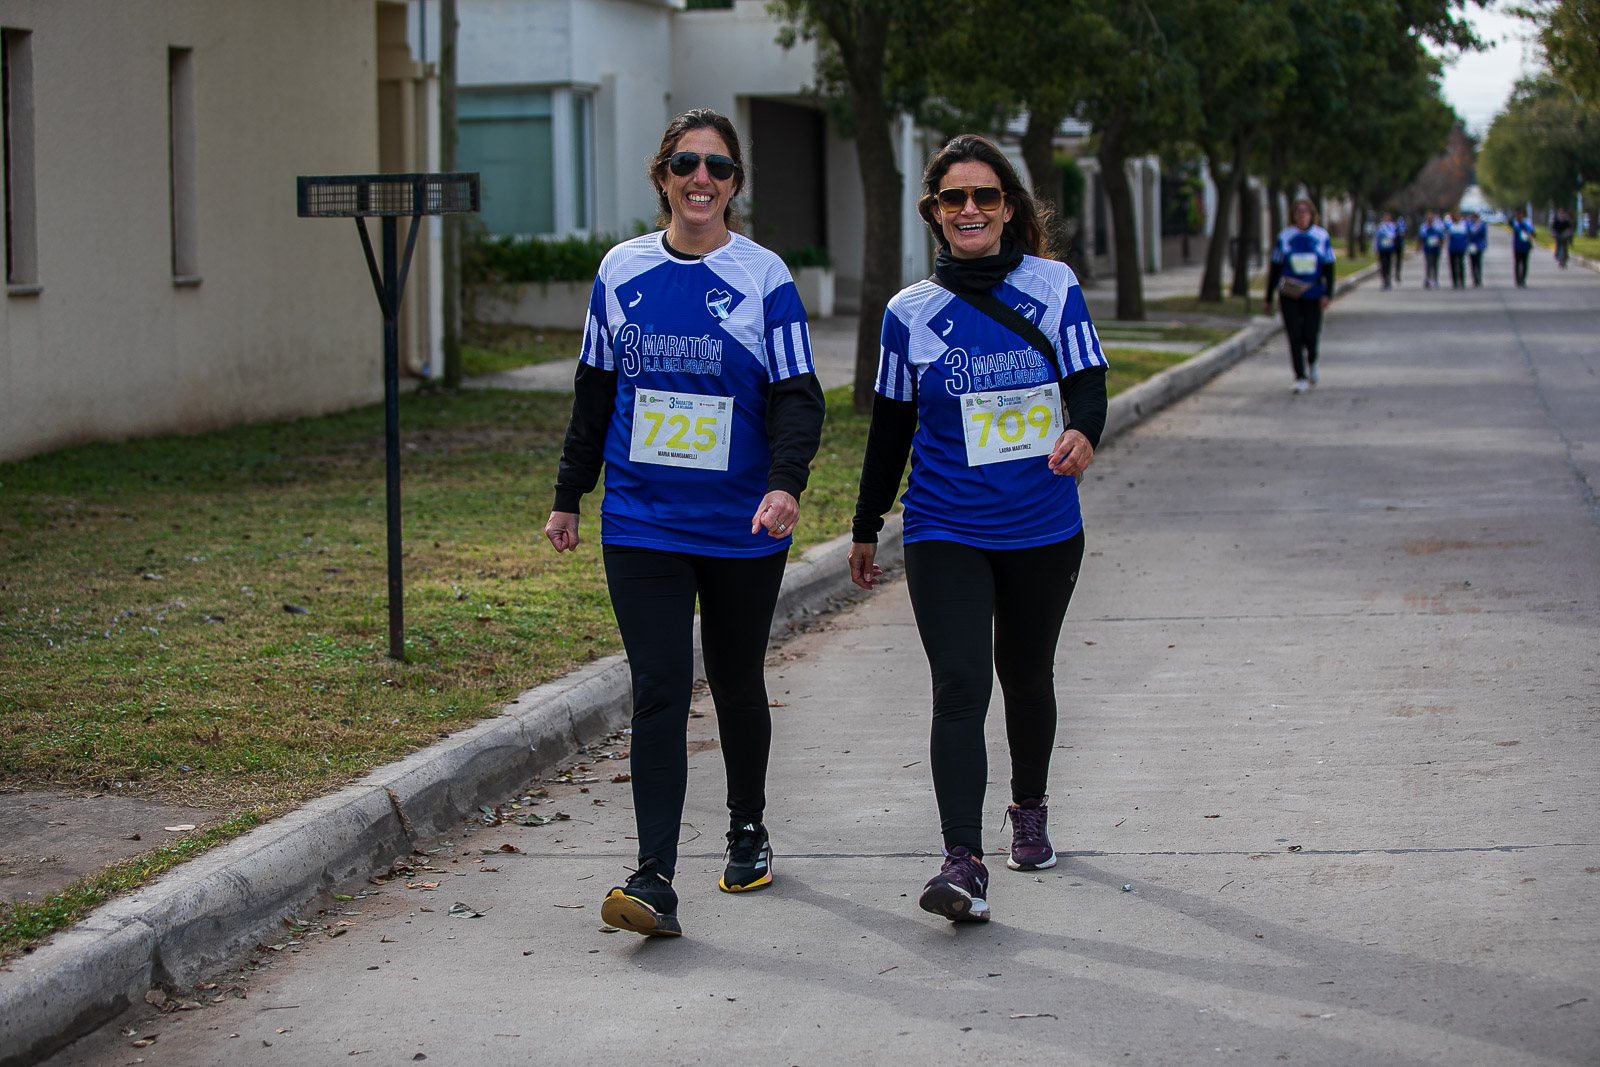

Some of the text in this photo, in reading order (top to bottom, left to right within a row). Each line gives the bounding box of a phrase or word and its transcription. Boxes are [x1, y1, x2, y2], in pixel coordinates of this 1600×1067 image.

[621, 323, 641, 377] 3
[642, 334, 722, 361] MARATÓN
[971, 346, 1046, 376] MARATÓN
[945, 347, 971, 397] 3
[669, 397, 676, 409] 3
[997, 395, 1004, 407] 3
[643, 411, 717, 452] 725
[971, 405, 1052, 448] 709
[998, 446, 1012, 454] LAURA
